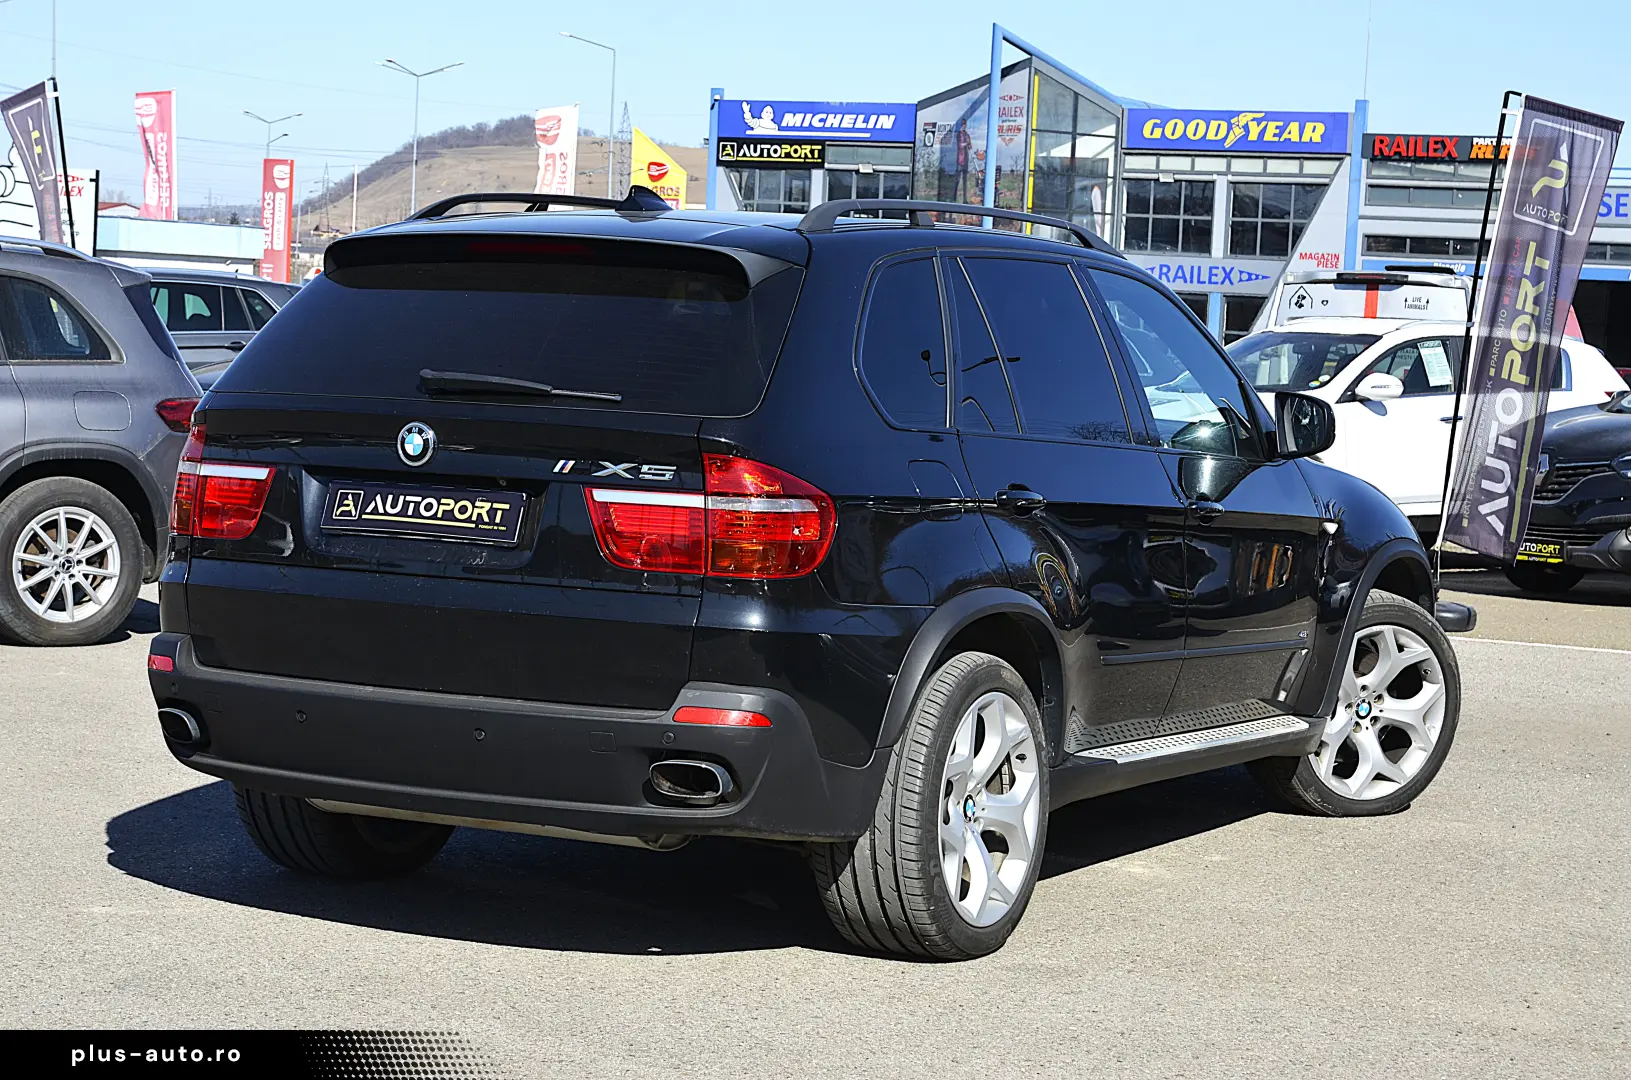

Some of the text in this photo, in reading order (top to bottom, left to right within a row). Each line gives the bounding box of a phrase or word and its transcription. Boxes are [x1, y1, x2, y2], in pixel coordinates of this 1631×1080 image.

[781, 113, 896, 129] MICHELIN
[738, 144, 822, 159] AUTOPORT
[1374, 135, 1459, 158] RAILEX
[263, 191, 274, 250] SELGROS
[1299, 252, 1340, 262] MAGAZIN
[1316, 260, 1339, 269] PIESE
[1158, 263, 1236, 287] RAILEX
[1490, 309, 1507, 367] PARC AUTO
[1477, 240, 1551, 537] AUTOPORT
[591, 461, 677, 481] X5
[365, 493, 511, 524] AUTOPORT
[1519, 542, 1561, 554] UTOPORT
